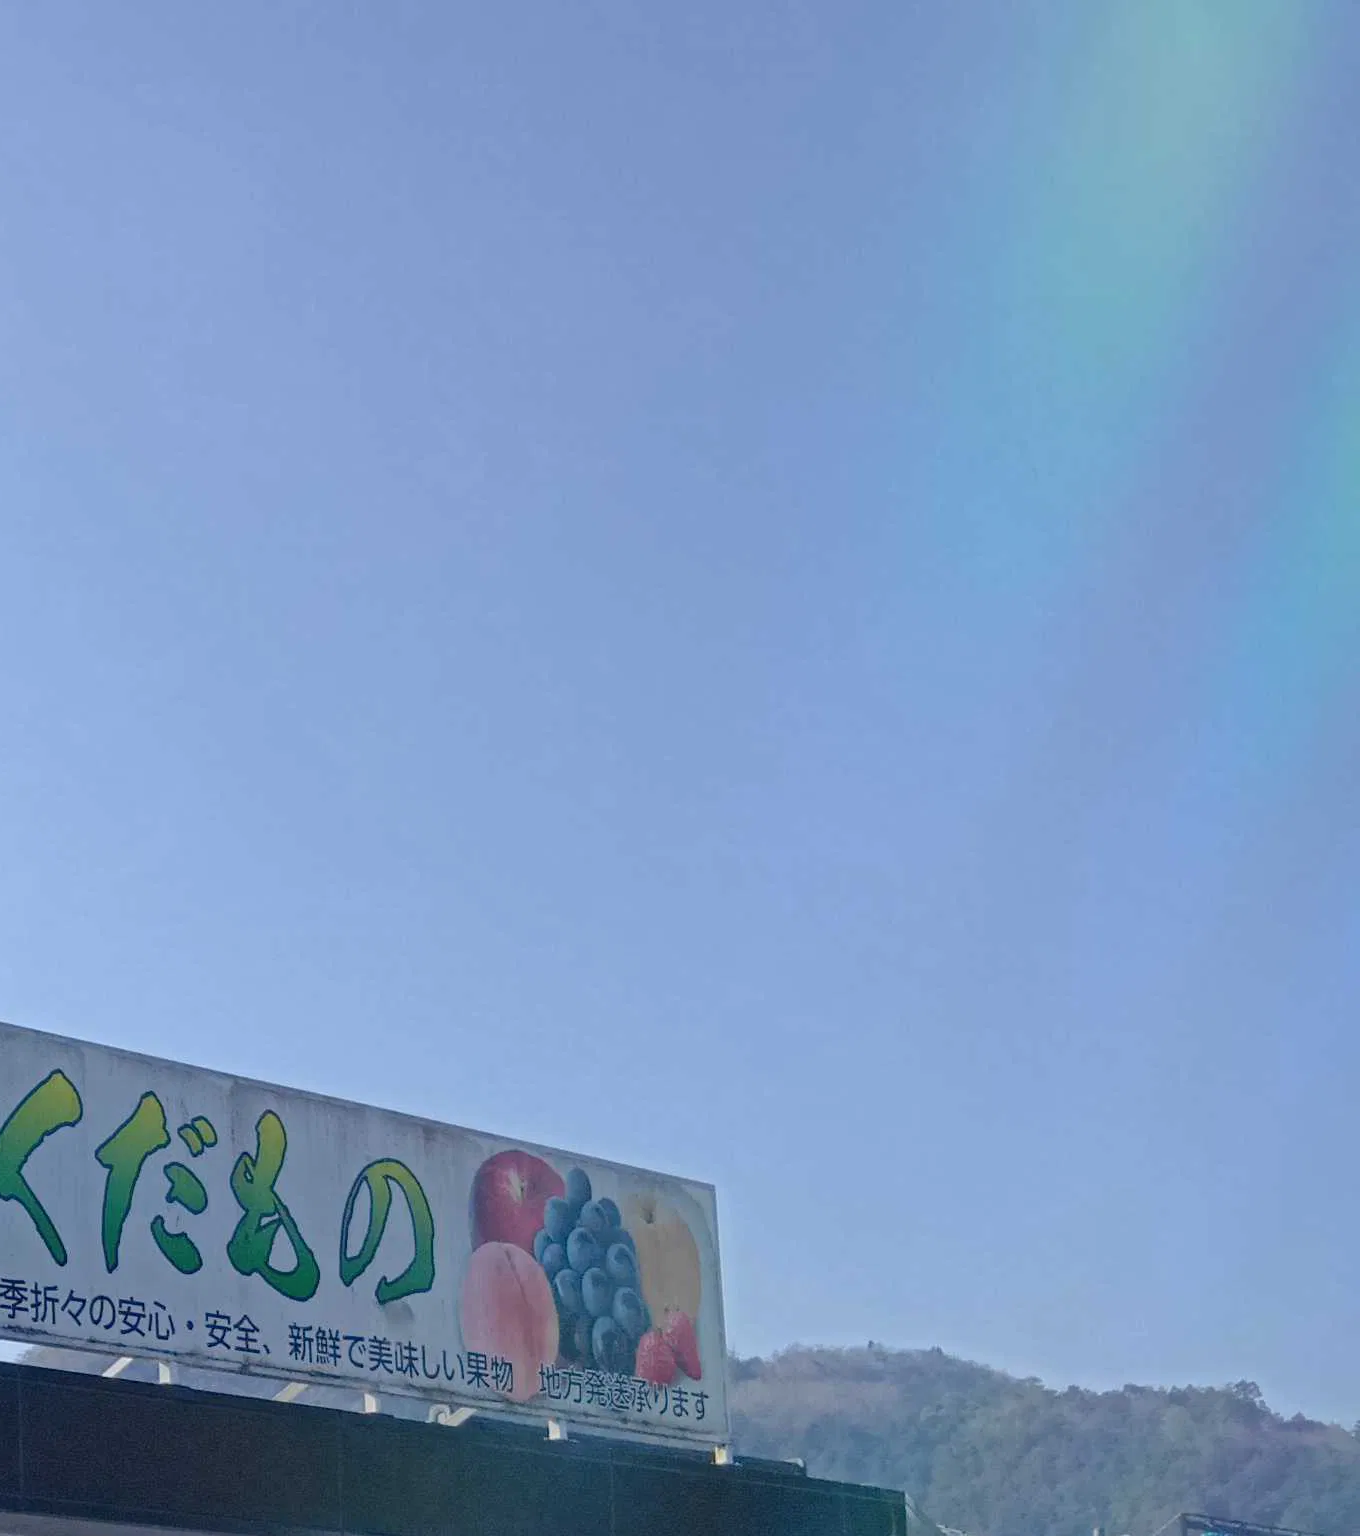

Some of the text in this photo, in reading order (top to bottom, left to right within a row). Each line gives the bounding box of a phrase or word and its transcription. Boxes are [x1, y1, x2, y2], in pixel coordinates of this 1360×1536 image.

[539, 1365, 710, 1421] 地方発送承ります
